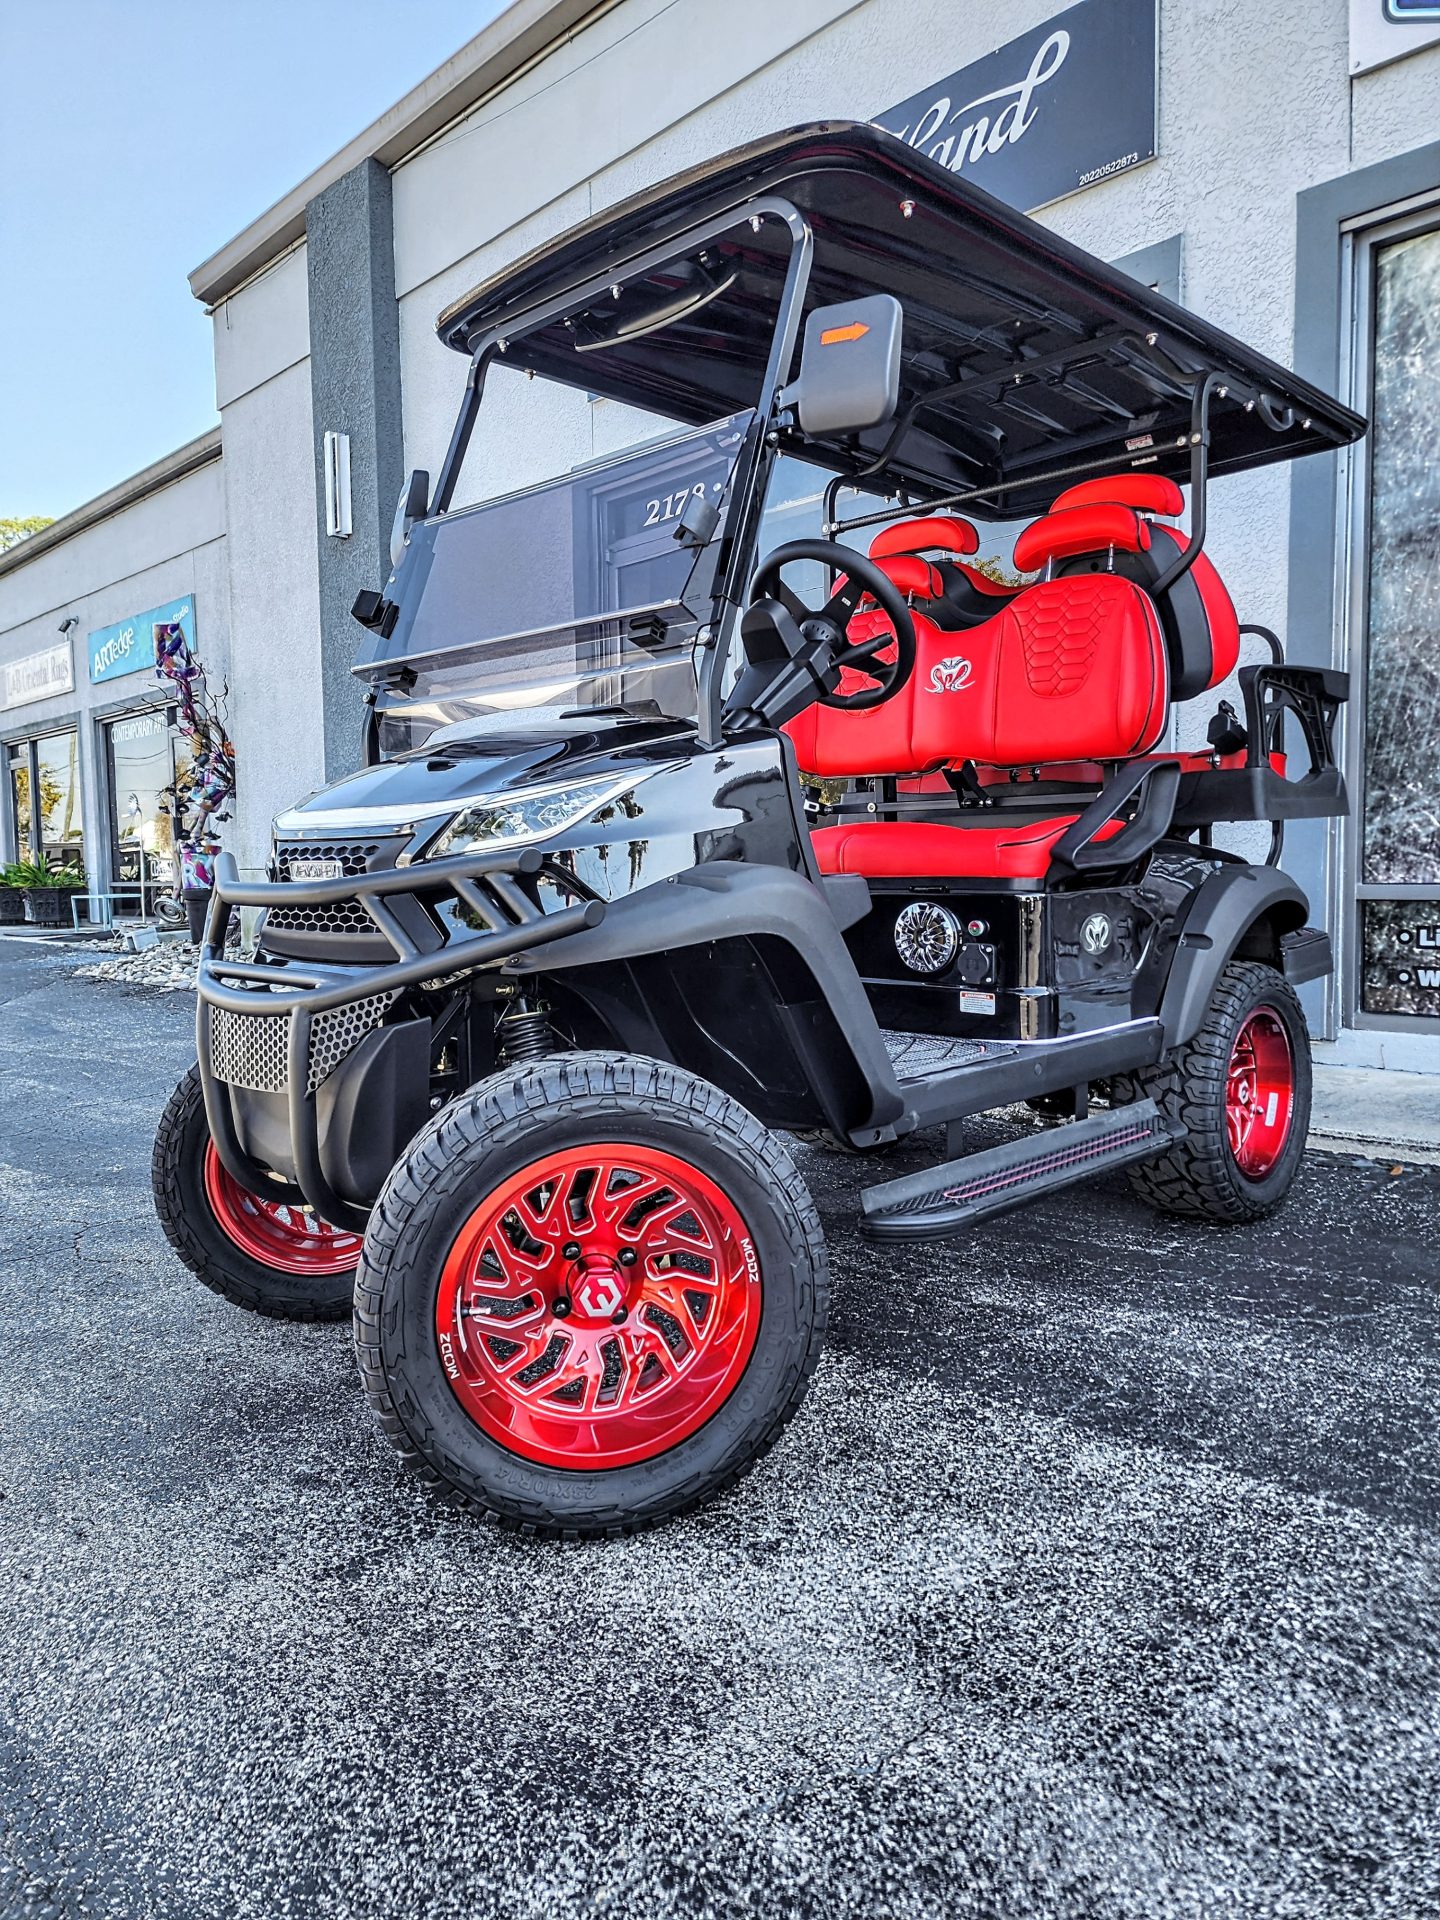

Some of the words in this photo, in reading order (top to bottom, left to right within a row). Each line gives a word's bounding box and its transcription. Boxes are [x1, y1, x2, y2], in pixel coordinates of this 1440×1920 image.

[892, 29, 1071, 173] land
[1079, 152, 1138, 186] 20220522873
[94, 627, 134, 678] ARTedge
[111, 718, 153, 744] CONTEMPORARY
[153, 715, 165, 734] ART
[740, 1237, 759, 1283] MODZ
[440, 1332, 460, 1380] MODZ
